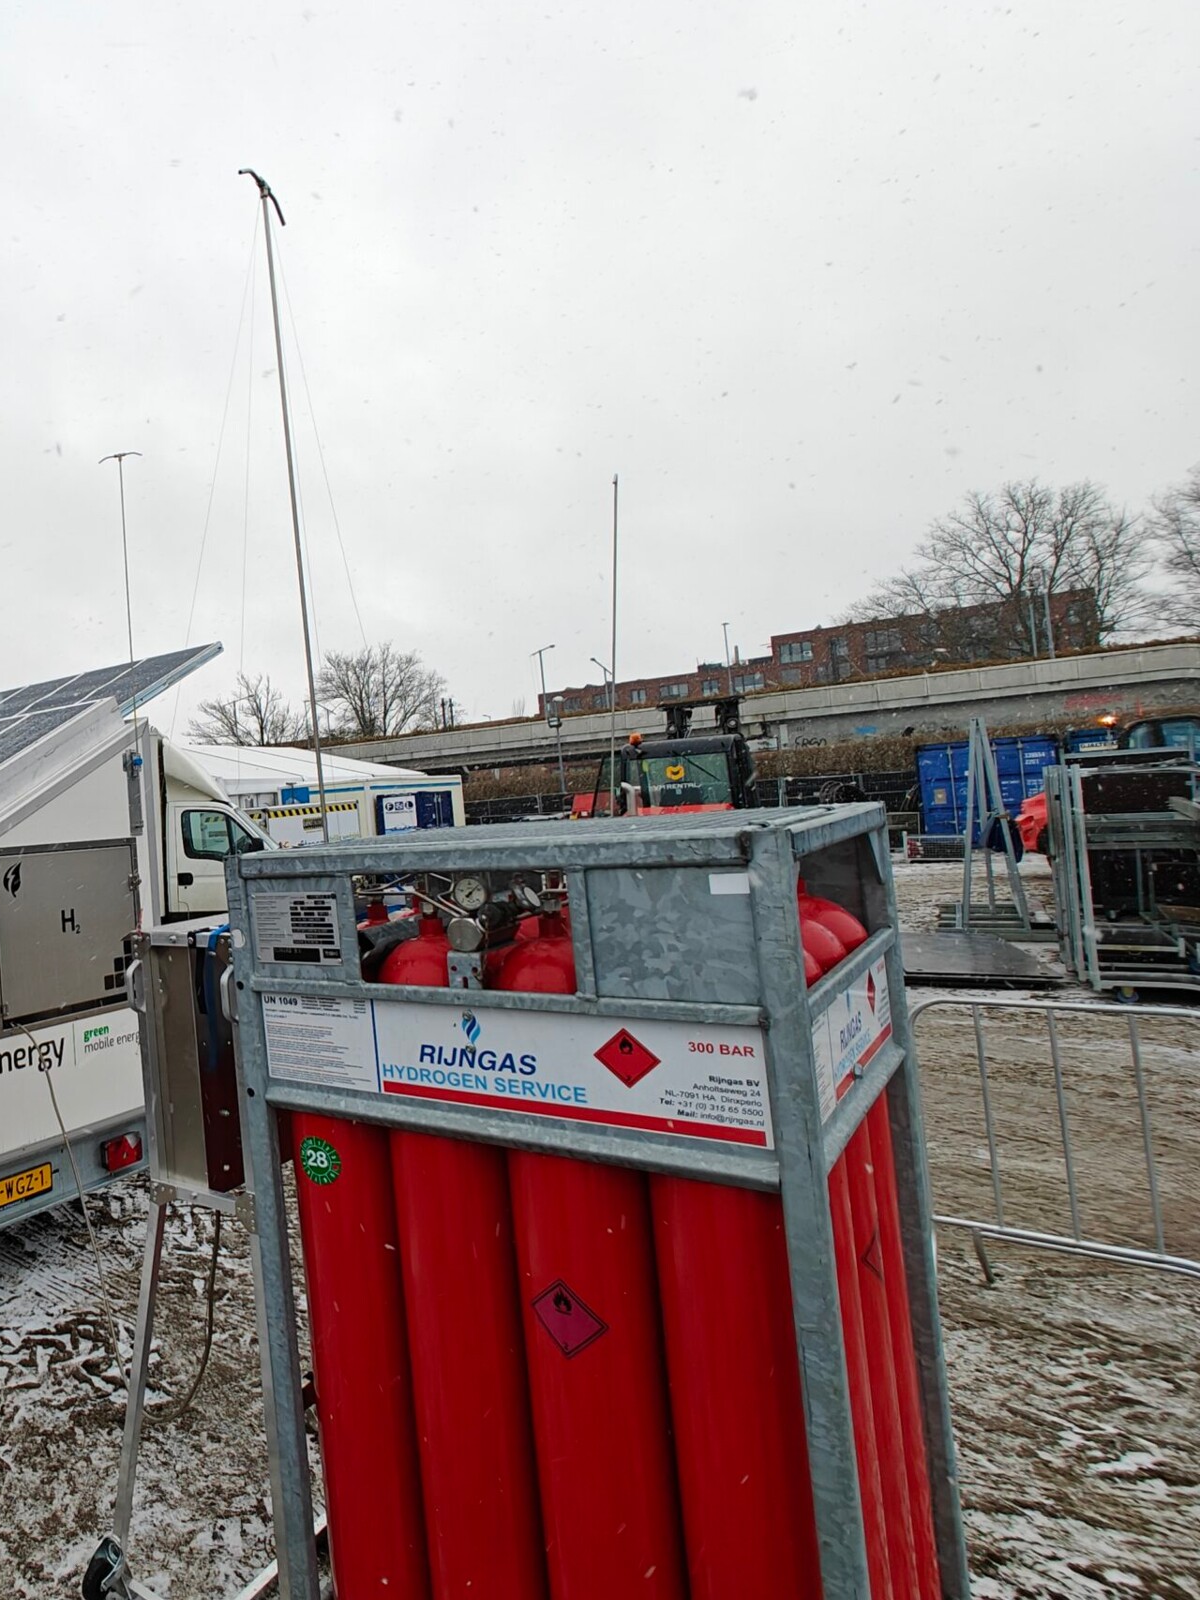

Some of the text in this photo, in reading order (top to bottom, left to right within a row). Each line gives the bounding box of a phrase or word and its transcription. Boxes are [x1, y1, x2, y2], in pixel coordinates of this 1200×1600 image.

[263, 995, 277, 1005] UN
[278, 997, 298, 1007] 1049
[83, 1025, 110, 1043] green
[84, 1031, 141, 1054] mobile energ
[688, 1041, 756, 1058] 300 BAR
[419, 1043, 537, 1076] RIJNGAS
[382, 1063, 589, 1104] HYDROGEN SERVICE
[708, 1075, 761, 1087] Rijngas BV
[664, 1089, 700, 1100] NL-7091
[702, 1093, 717, 1101] HA
[750, 1089, 762, 1097] 24
[659, 1098, 675, 1106] Tel:
[695, 1102, 707, 1111] (0)
[709, 1103, 726, 1113] 315
[728, 1106, 740, 1114] 65
[741, 1108, 764, 1117] 5500
[677, 1109, 698, 1118] Mail:
[306, 1149, 329, 1169] 28
